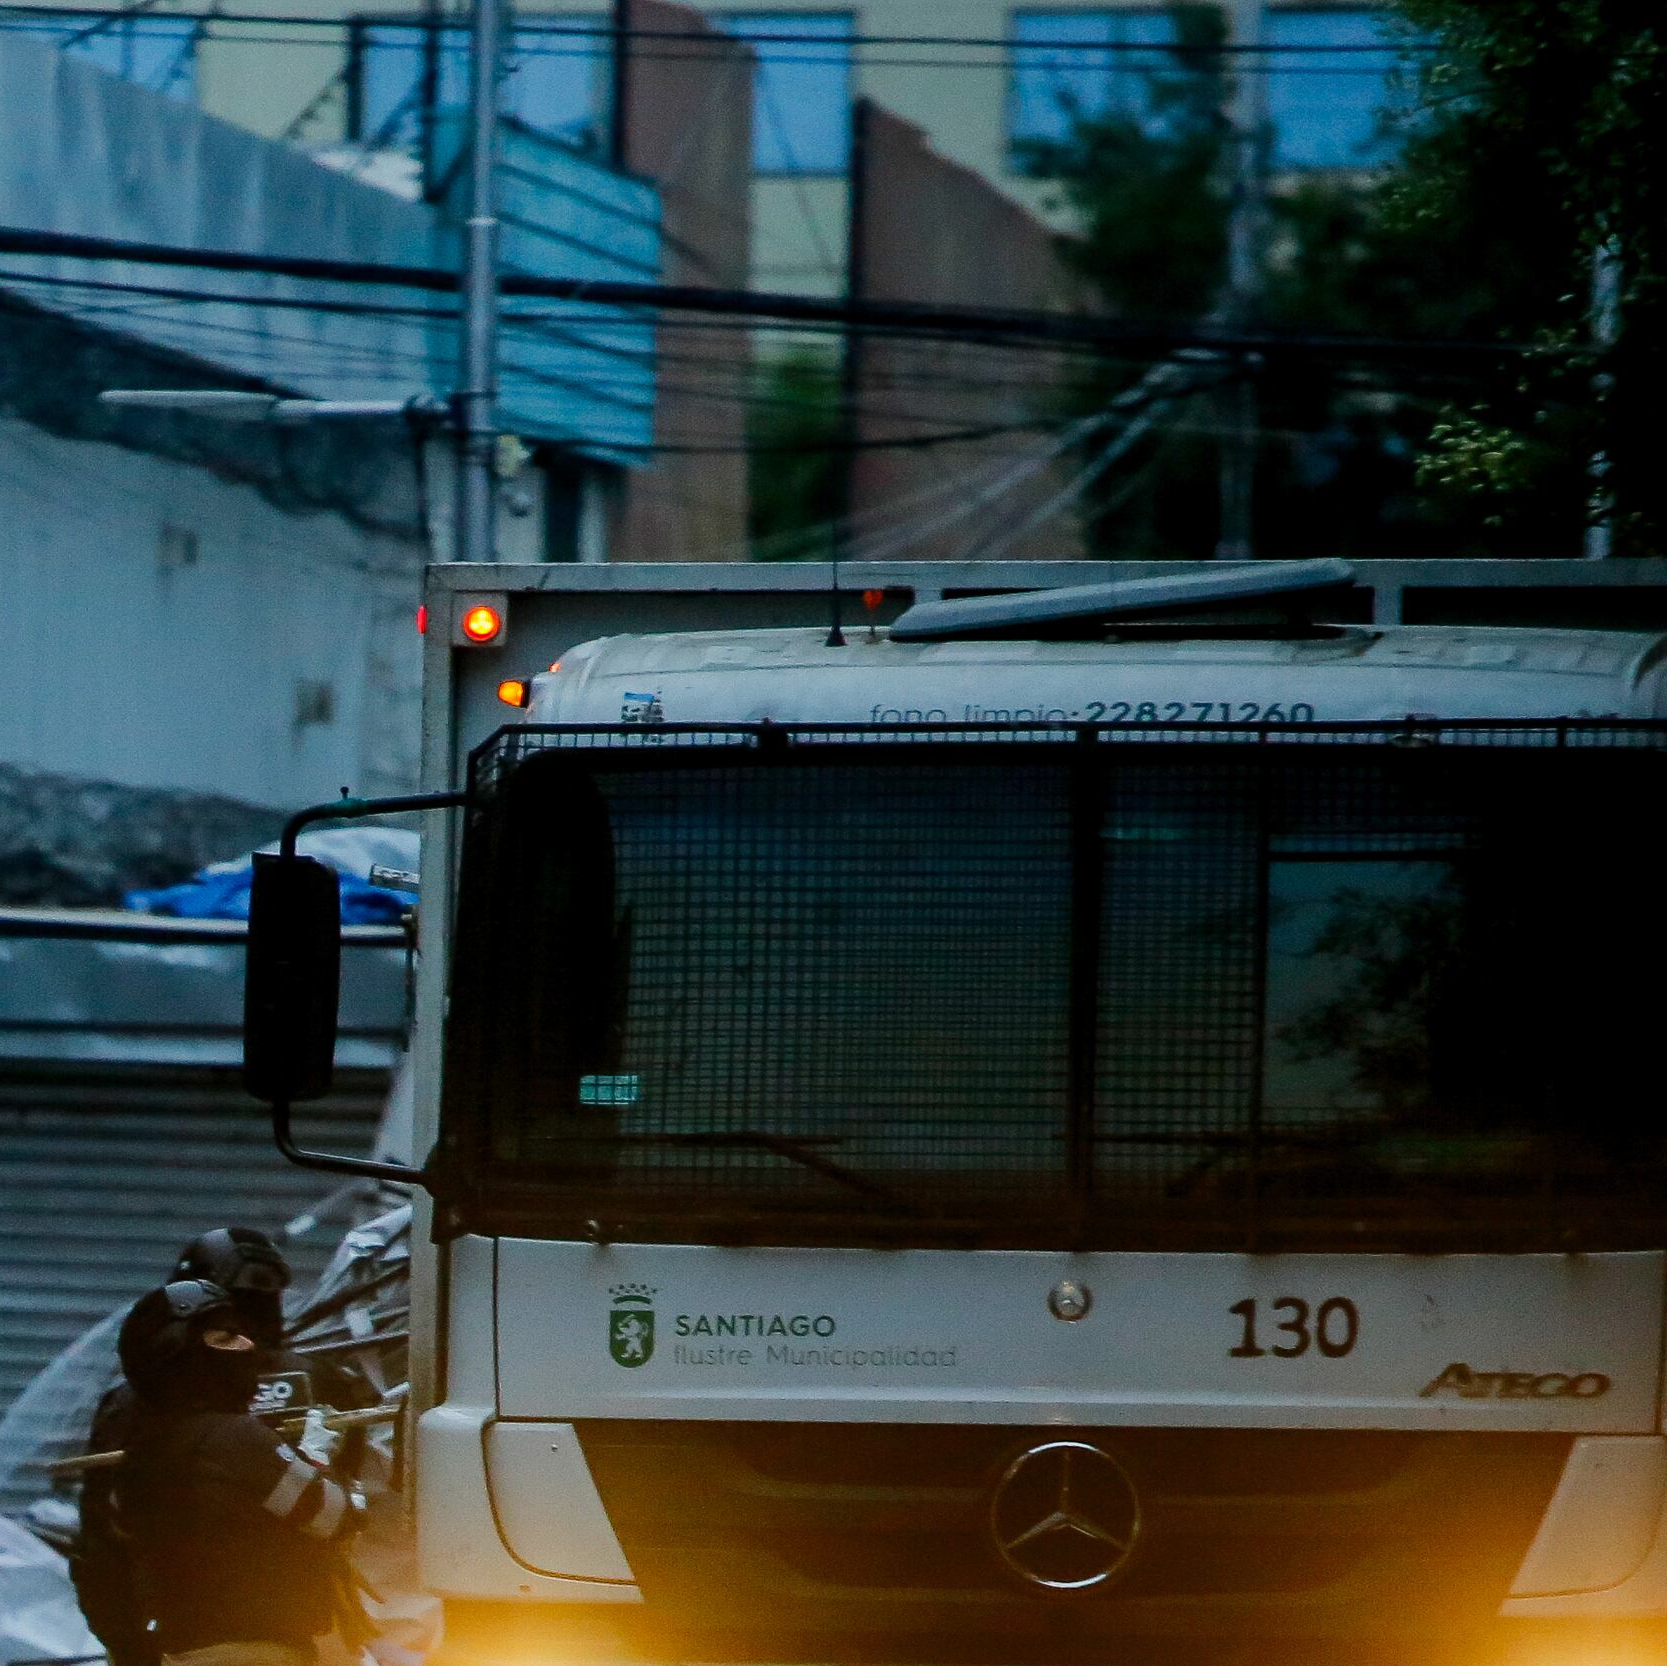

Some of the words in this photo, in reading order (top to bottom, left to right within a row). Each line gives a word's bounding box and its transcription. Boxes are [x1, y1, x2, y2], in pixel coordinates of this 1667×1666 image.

[673, 1313, 836, 1338] SANTIAGO
[1227, 1297, 1360, 1358] 130
[673, 1344, 753, 1366] Ilustre
[766, 1344, 957, 1370] Municipalidad
